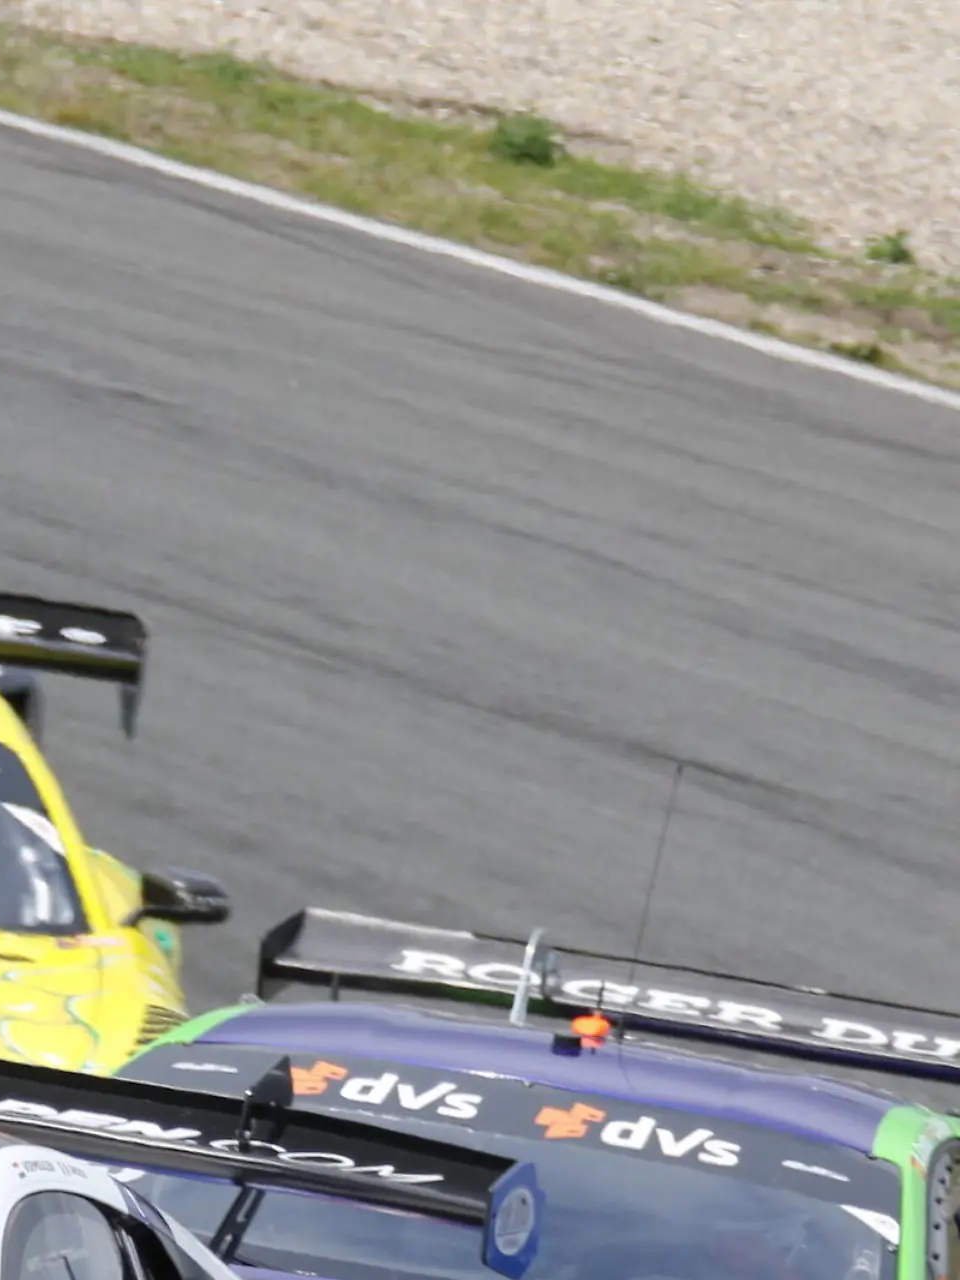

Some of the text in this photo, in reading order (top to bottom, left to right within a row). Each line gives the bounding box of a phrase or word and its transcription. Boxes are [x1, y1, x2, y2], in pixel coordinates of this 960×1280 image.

[391, 949, 782, 1031] ROGER
[340, 1073, 484, 1121] dvs
[600, 1114, 741, 1168] dvs
